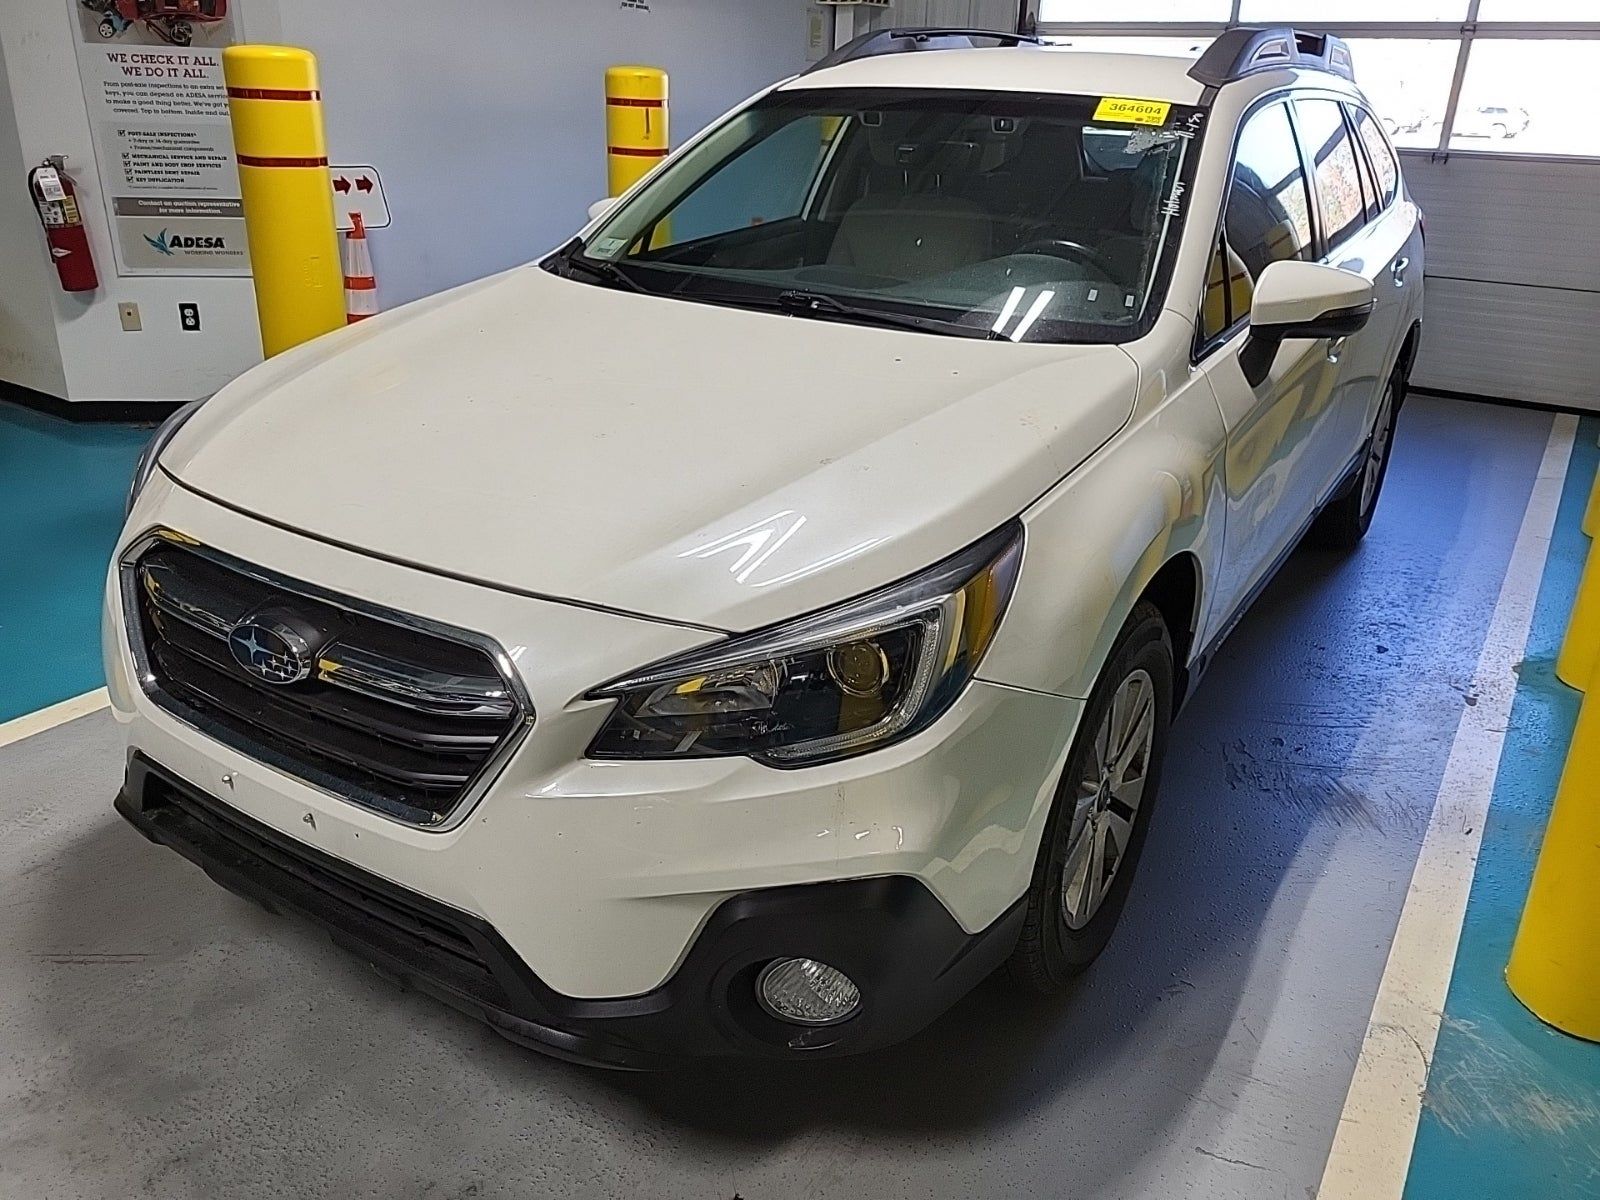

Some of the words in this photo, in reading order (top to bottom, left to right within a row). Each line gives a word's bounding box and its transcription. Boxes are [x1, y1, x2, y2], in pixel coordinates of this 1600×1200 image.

[106, 53, 127, 63] WE
[130, 53, 176, 65] CHECK
[177, 56, 190, 65] IT
[193, 56, 219, 66] ALL.
[121, 66, 141, 77] WE
[145, 67, 163, 77] DO
[167, 68, 179, 77] IT
[183, 69, 209, 79] ALL.
[1109, 103, 1162, 114] 364604
[169, 235, 225, 248] ADESA
